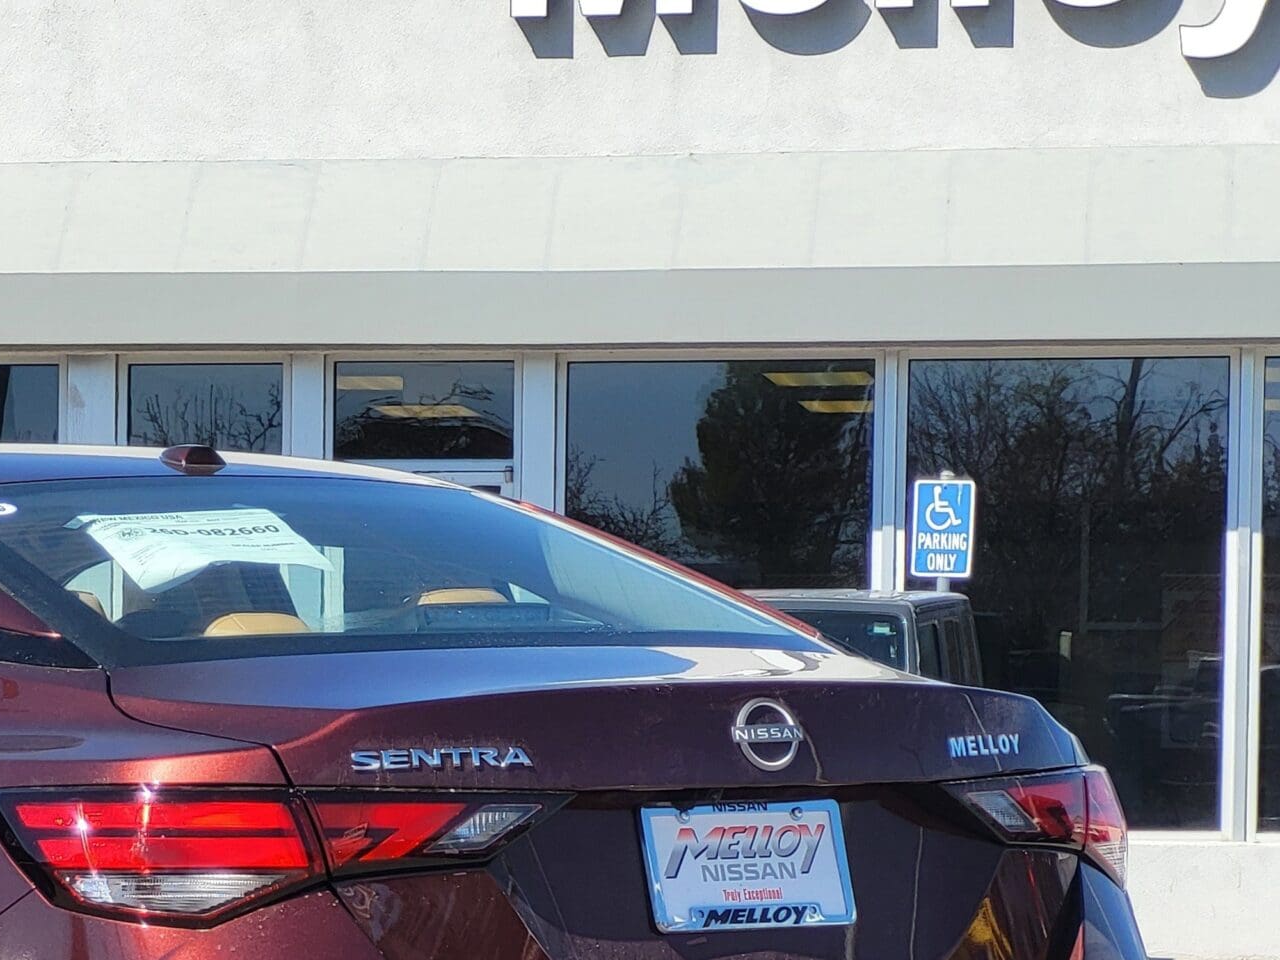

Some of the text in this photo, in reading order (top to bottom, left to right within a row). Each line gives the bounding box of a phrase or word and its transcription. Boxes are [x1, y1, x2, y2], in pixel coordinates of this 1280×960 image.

[918, 532, 968, 551] PARKING
[927, 553, 957, 571] ONLY
[735, 728, 803, 740] NISSAN
[948, 733, 1019, 758] MELLOY
[351, 747, 534, 770] SENTRA
[712, 801, 768, 812] NISSAN
[664, 824, 825, 879] MELLOY
[701, 861, 797, 882] NISSAN
[722, 887, 783, 903] Truly Exceptional
[703, 905, 808, 928] MELLOY
